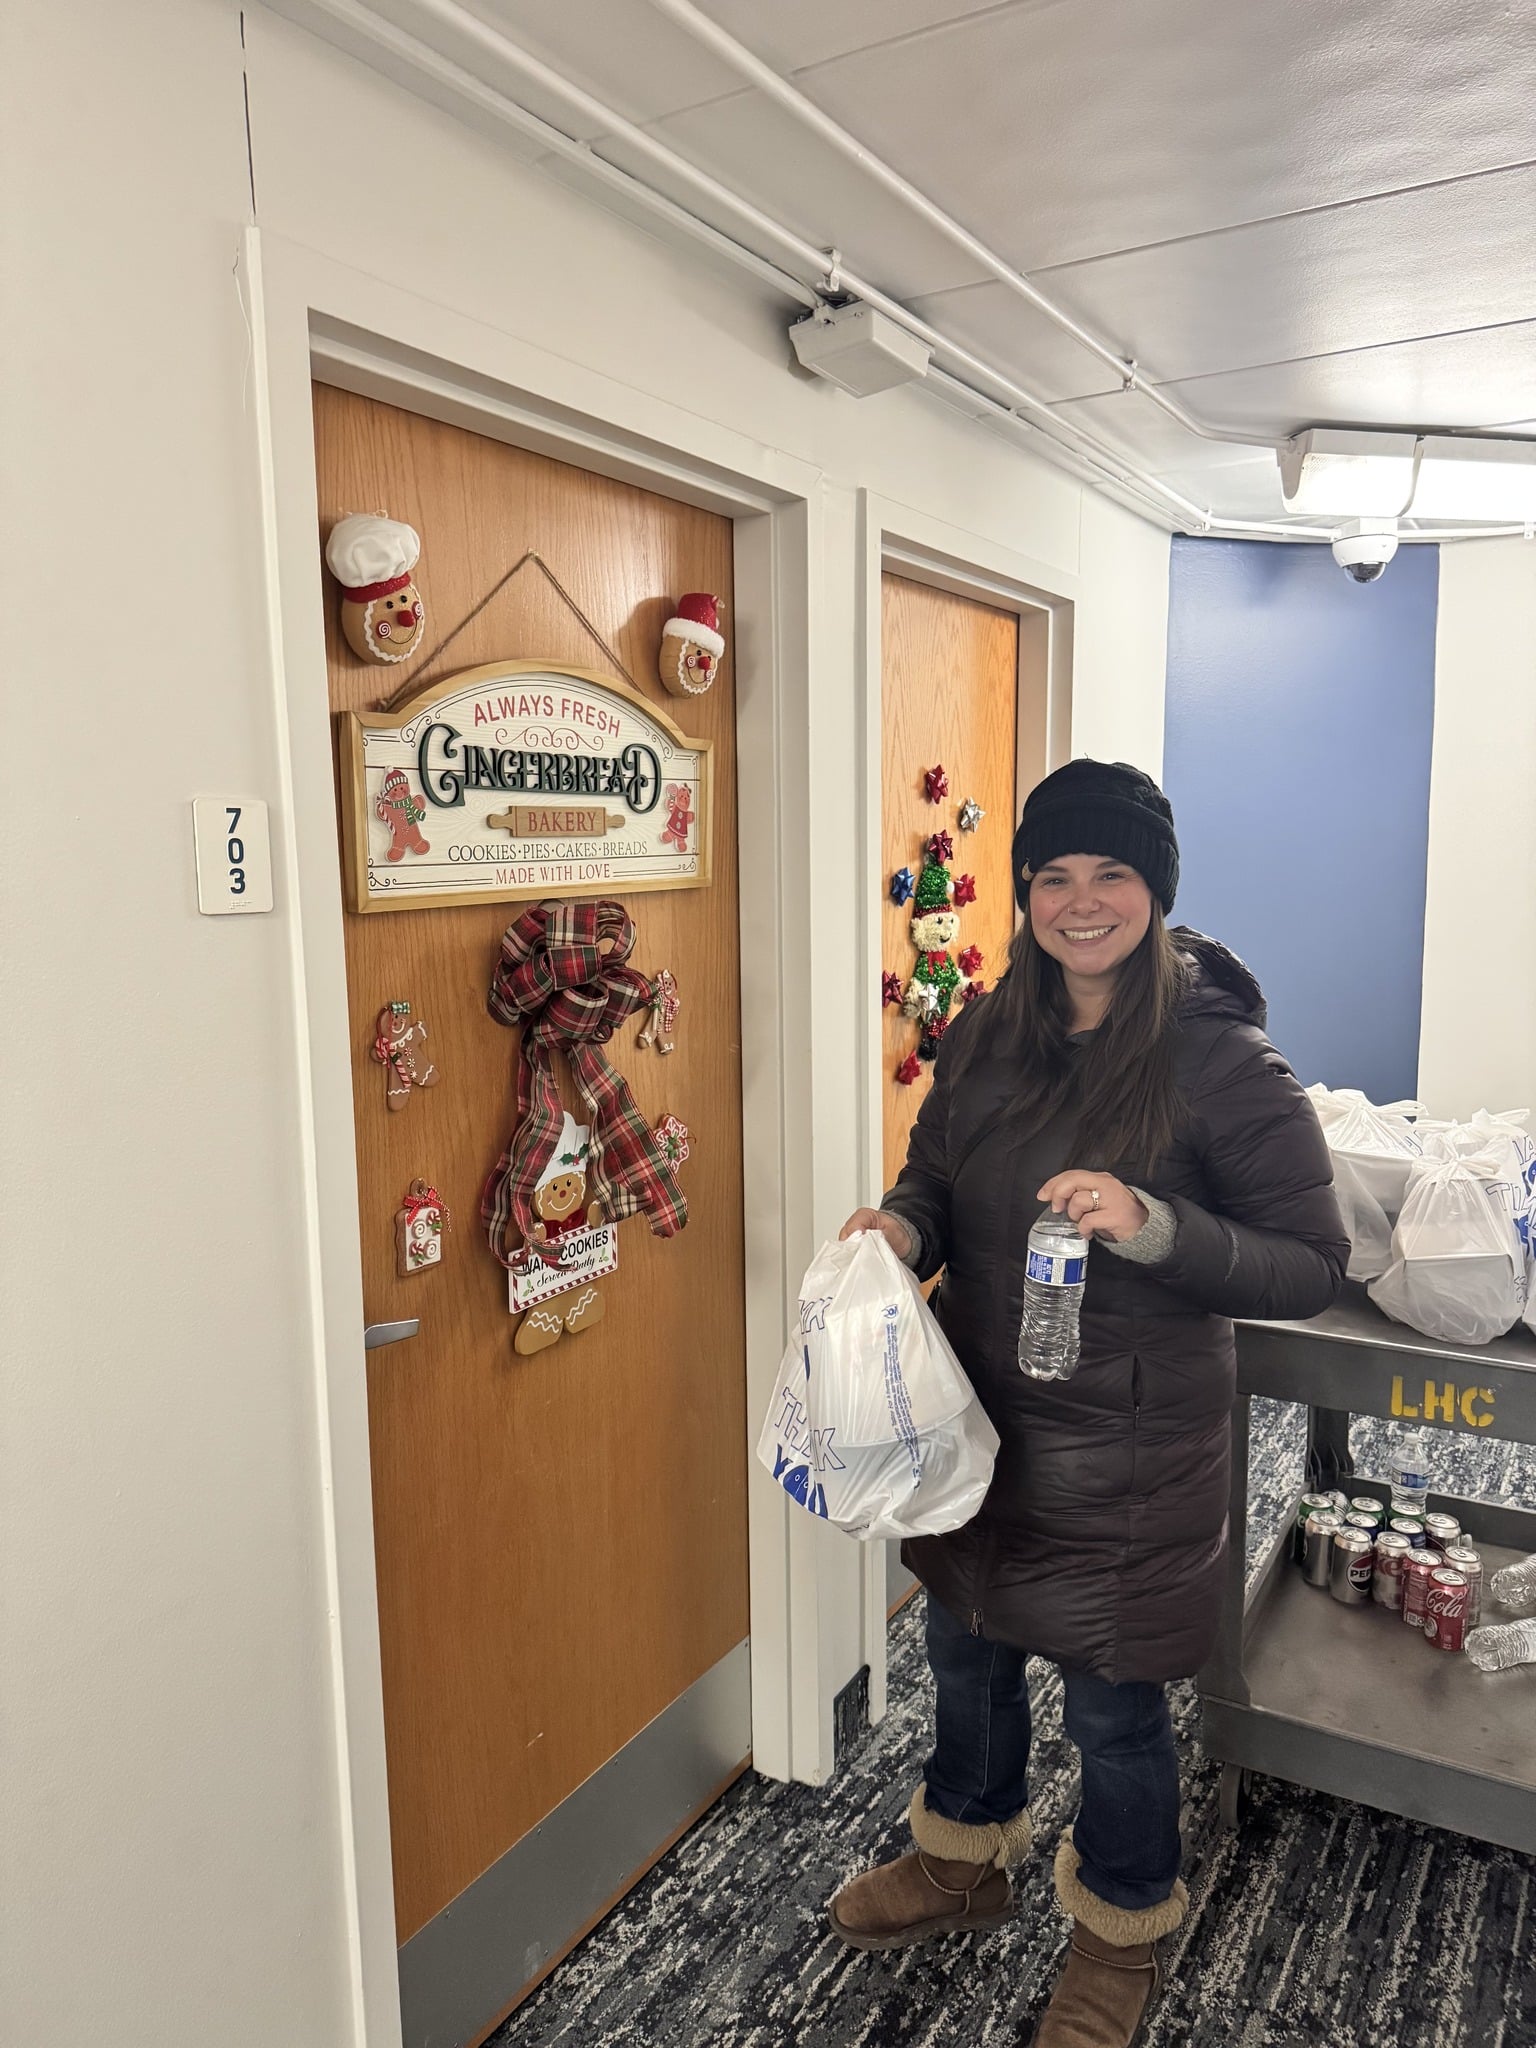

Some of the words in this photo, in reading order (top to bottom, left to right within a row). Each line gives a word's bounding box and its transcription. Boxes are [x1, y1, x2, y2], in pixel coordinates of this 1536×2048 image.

[474, 694, 554, 727] ALWAYS
[561, 698, 621, 738] FRESH
[418, 723, 662, 814] GINGERBREAD
[528, 811, 597, 832] BAKERY
[225, 807, 246, 894] 703
[495, 867, 535, 885] MADE
[539, 865, 573, 882] WITH
[578, 863, 611, 880] LOVE
[1391, 1375, 1496, 1427] LHC
[1425, 1588, 1465, 1618] Cola
